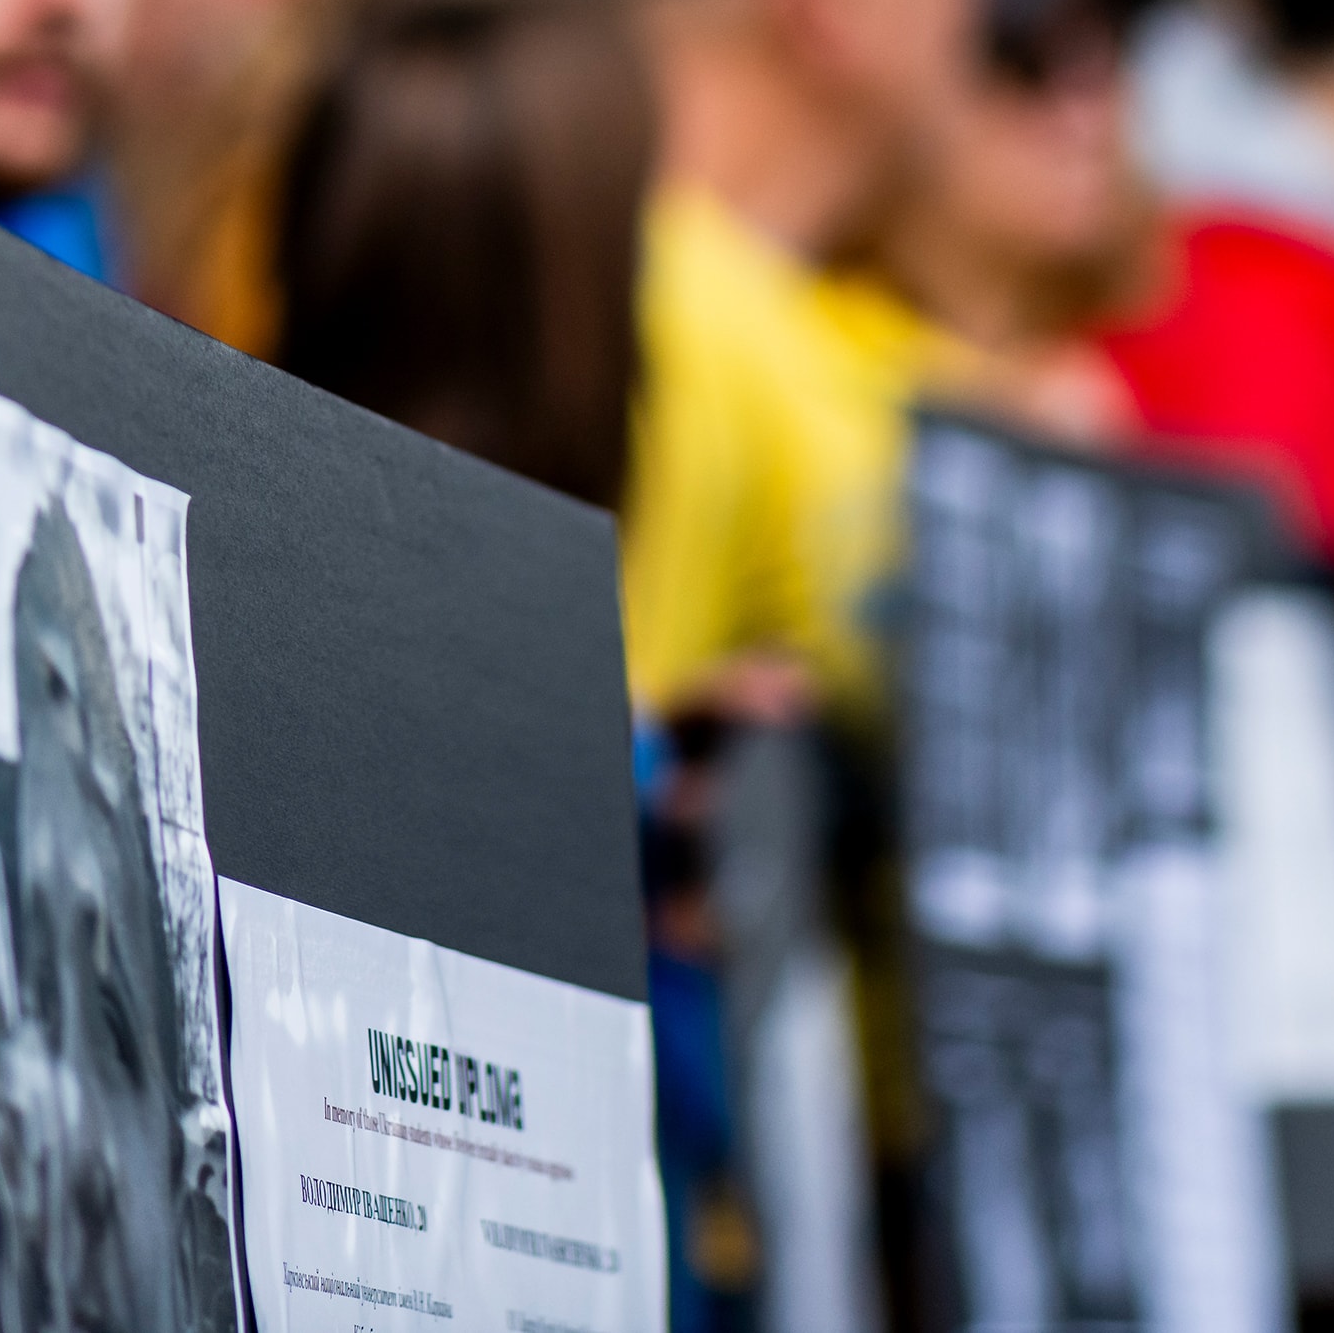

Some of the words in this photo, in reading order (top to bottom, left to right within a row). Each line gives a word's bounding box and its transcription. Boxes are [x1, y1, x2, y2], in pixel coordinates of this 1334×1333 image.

[368, 1027, 451, 1111] UNISSUED
[324, 1097, 331, 1120] In
[332, 1105, 356, 1133] memory
[356, 1106, 363, 1129] of
[299, 1174, 362, 1216] ВОЛОДИМИР
[282, 1261, 320, 1294] Харківський
[320, 1271, 361, 1300] національний
